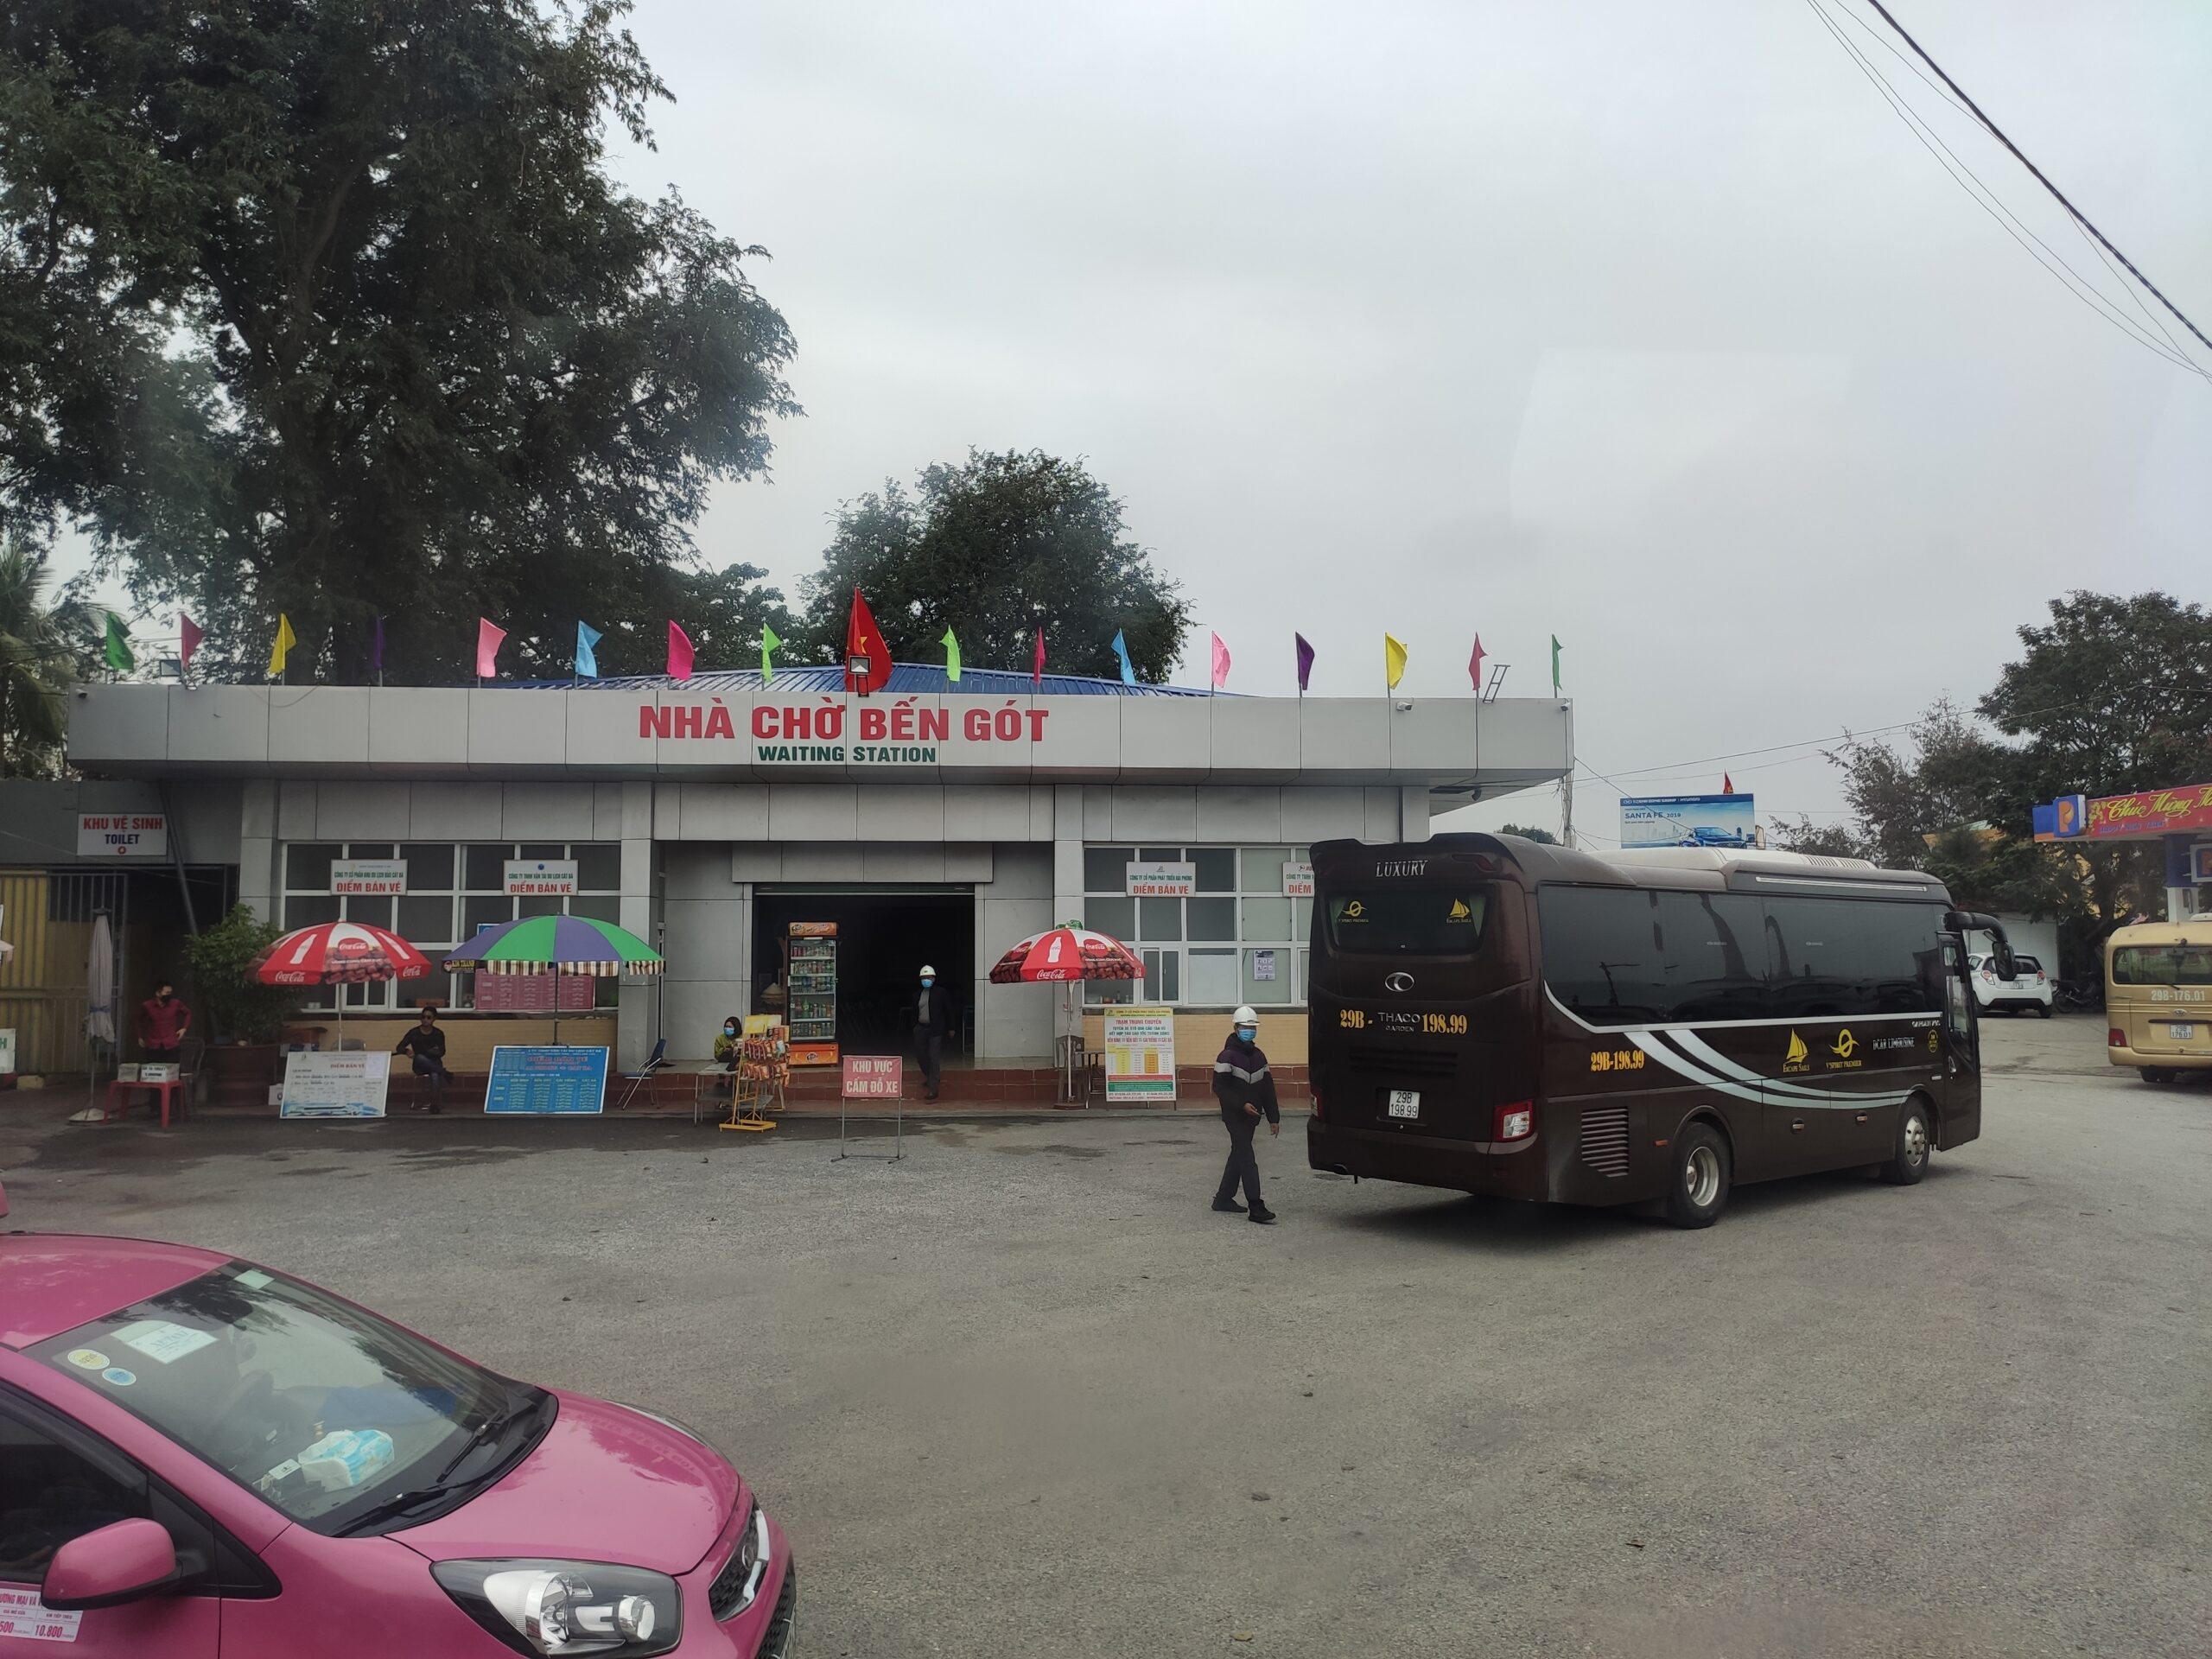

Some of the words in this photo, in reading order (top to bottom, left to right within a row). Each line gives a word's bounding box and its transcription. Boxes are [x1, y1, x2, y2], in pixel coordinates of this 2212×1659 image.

[639, 697, 734, 739] NHÀ
[752, 696, 845, 740] CHỜ
[860, 696, 950, 741] BẾN
[963, 699, 1048, 742] GÓT
[758, 746, 844, 761] WAITING
[853, 746, 937, 763] STATION
[83, 817, 109, 830] KHU
[113, 815, 128, 832] VỆ
[132, 817, 162, 830] SINH
[105, 834, 140, 844] TOILET
[1376, 860, 1428, 877] LUXURY
[337, 879, 362, 892] ĐIỂM
[365, 880, 386, 892] BÁN
[390, 880, 401, 892] VÉ
[511, 880, 534, 893] ĐIỂM
[538, 881, 557, 893] BÁN
[561, 881, 572, 893] VÉ
[1133, 881, 1155, 894] ĐIỂM
[1158, 883, 1176, 894] BÁN
[1179, 883, 1189, 894] VÉ
[1288, 881, 1311, 894] ĐIỂM
[2151, 989, 2206, 1001] 29B-176.01
[1340, 1009, 1365, 1028] 29B
[1422, 1013, 1468, 1034] 198.99
[1377, 1012, 1421, 1023] THACO
[853, 1060, 871, 1072] KHU
[874, 1060, 893, 1074] VỰC
[1591, 1050, 1645, 1072] 29B-198.99
[846, 1077, 868, 1093] CẤM
[870, 1077, 883, 1093] ĐỖ
[886, 1081, 898, 1093] XE
[1396, 1092, 1412, 1104] 29B
[1391, 1103, 1417, 1117] 198.99
[35, 1624, 63, 1638] 10.800
